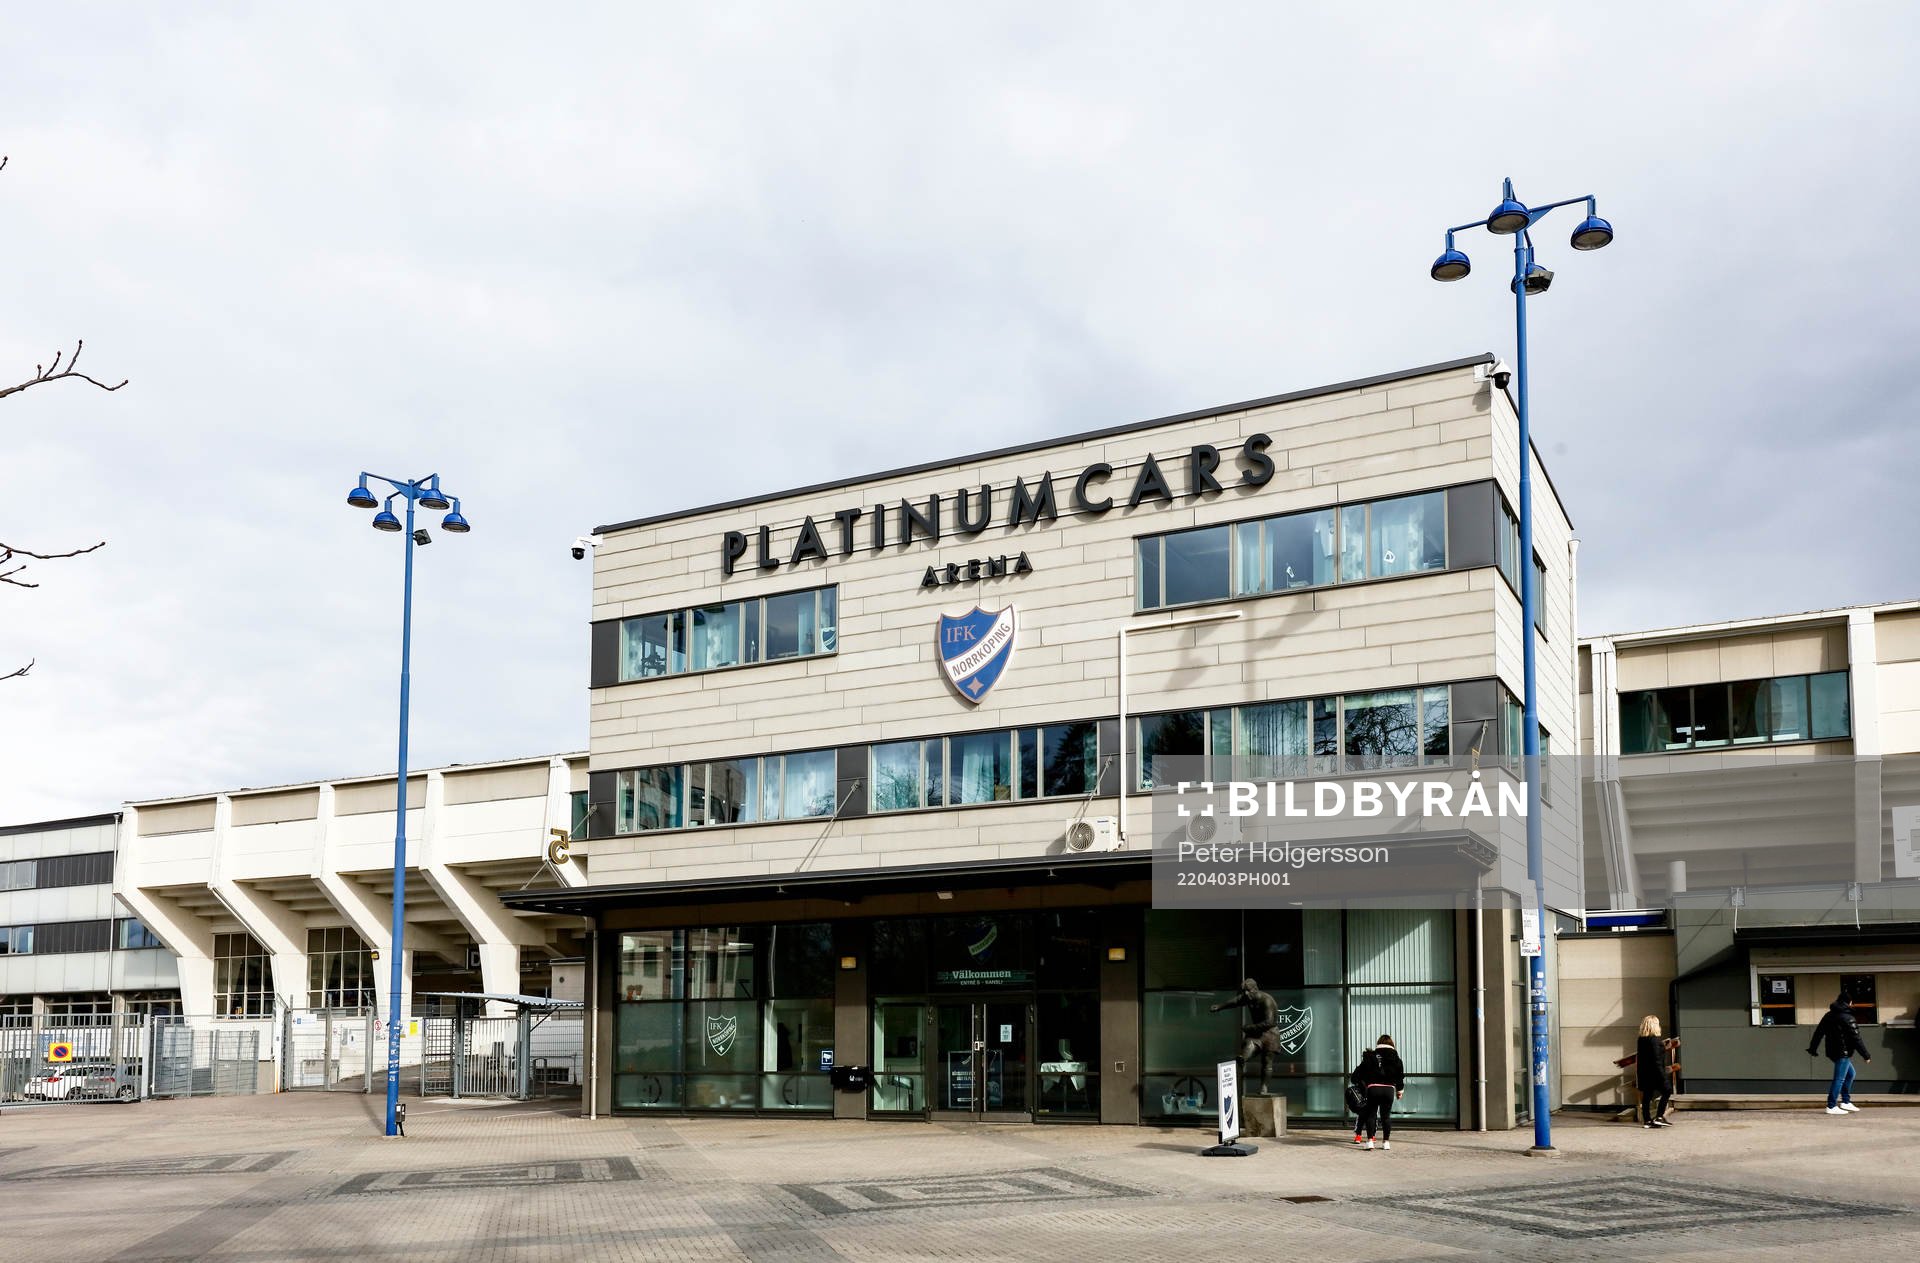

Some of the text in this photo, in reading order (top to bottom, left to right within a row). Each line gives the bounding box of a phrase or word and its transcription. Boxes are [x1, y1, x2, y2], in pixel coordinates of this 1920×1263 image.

[724, 433, 1275, 576] PLATINUMCARS
[921, 551, 1033, 587] ARENA
[945, 624, 977, 643] IFK
[952, 622, 1011, 677] NORRKÖPING
[952, 969, 1012, 979] Välkommen
[710, 1022, 722, 1030] IFK
[1279, 1014, 1292, 1024] FK
